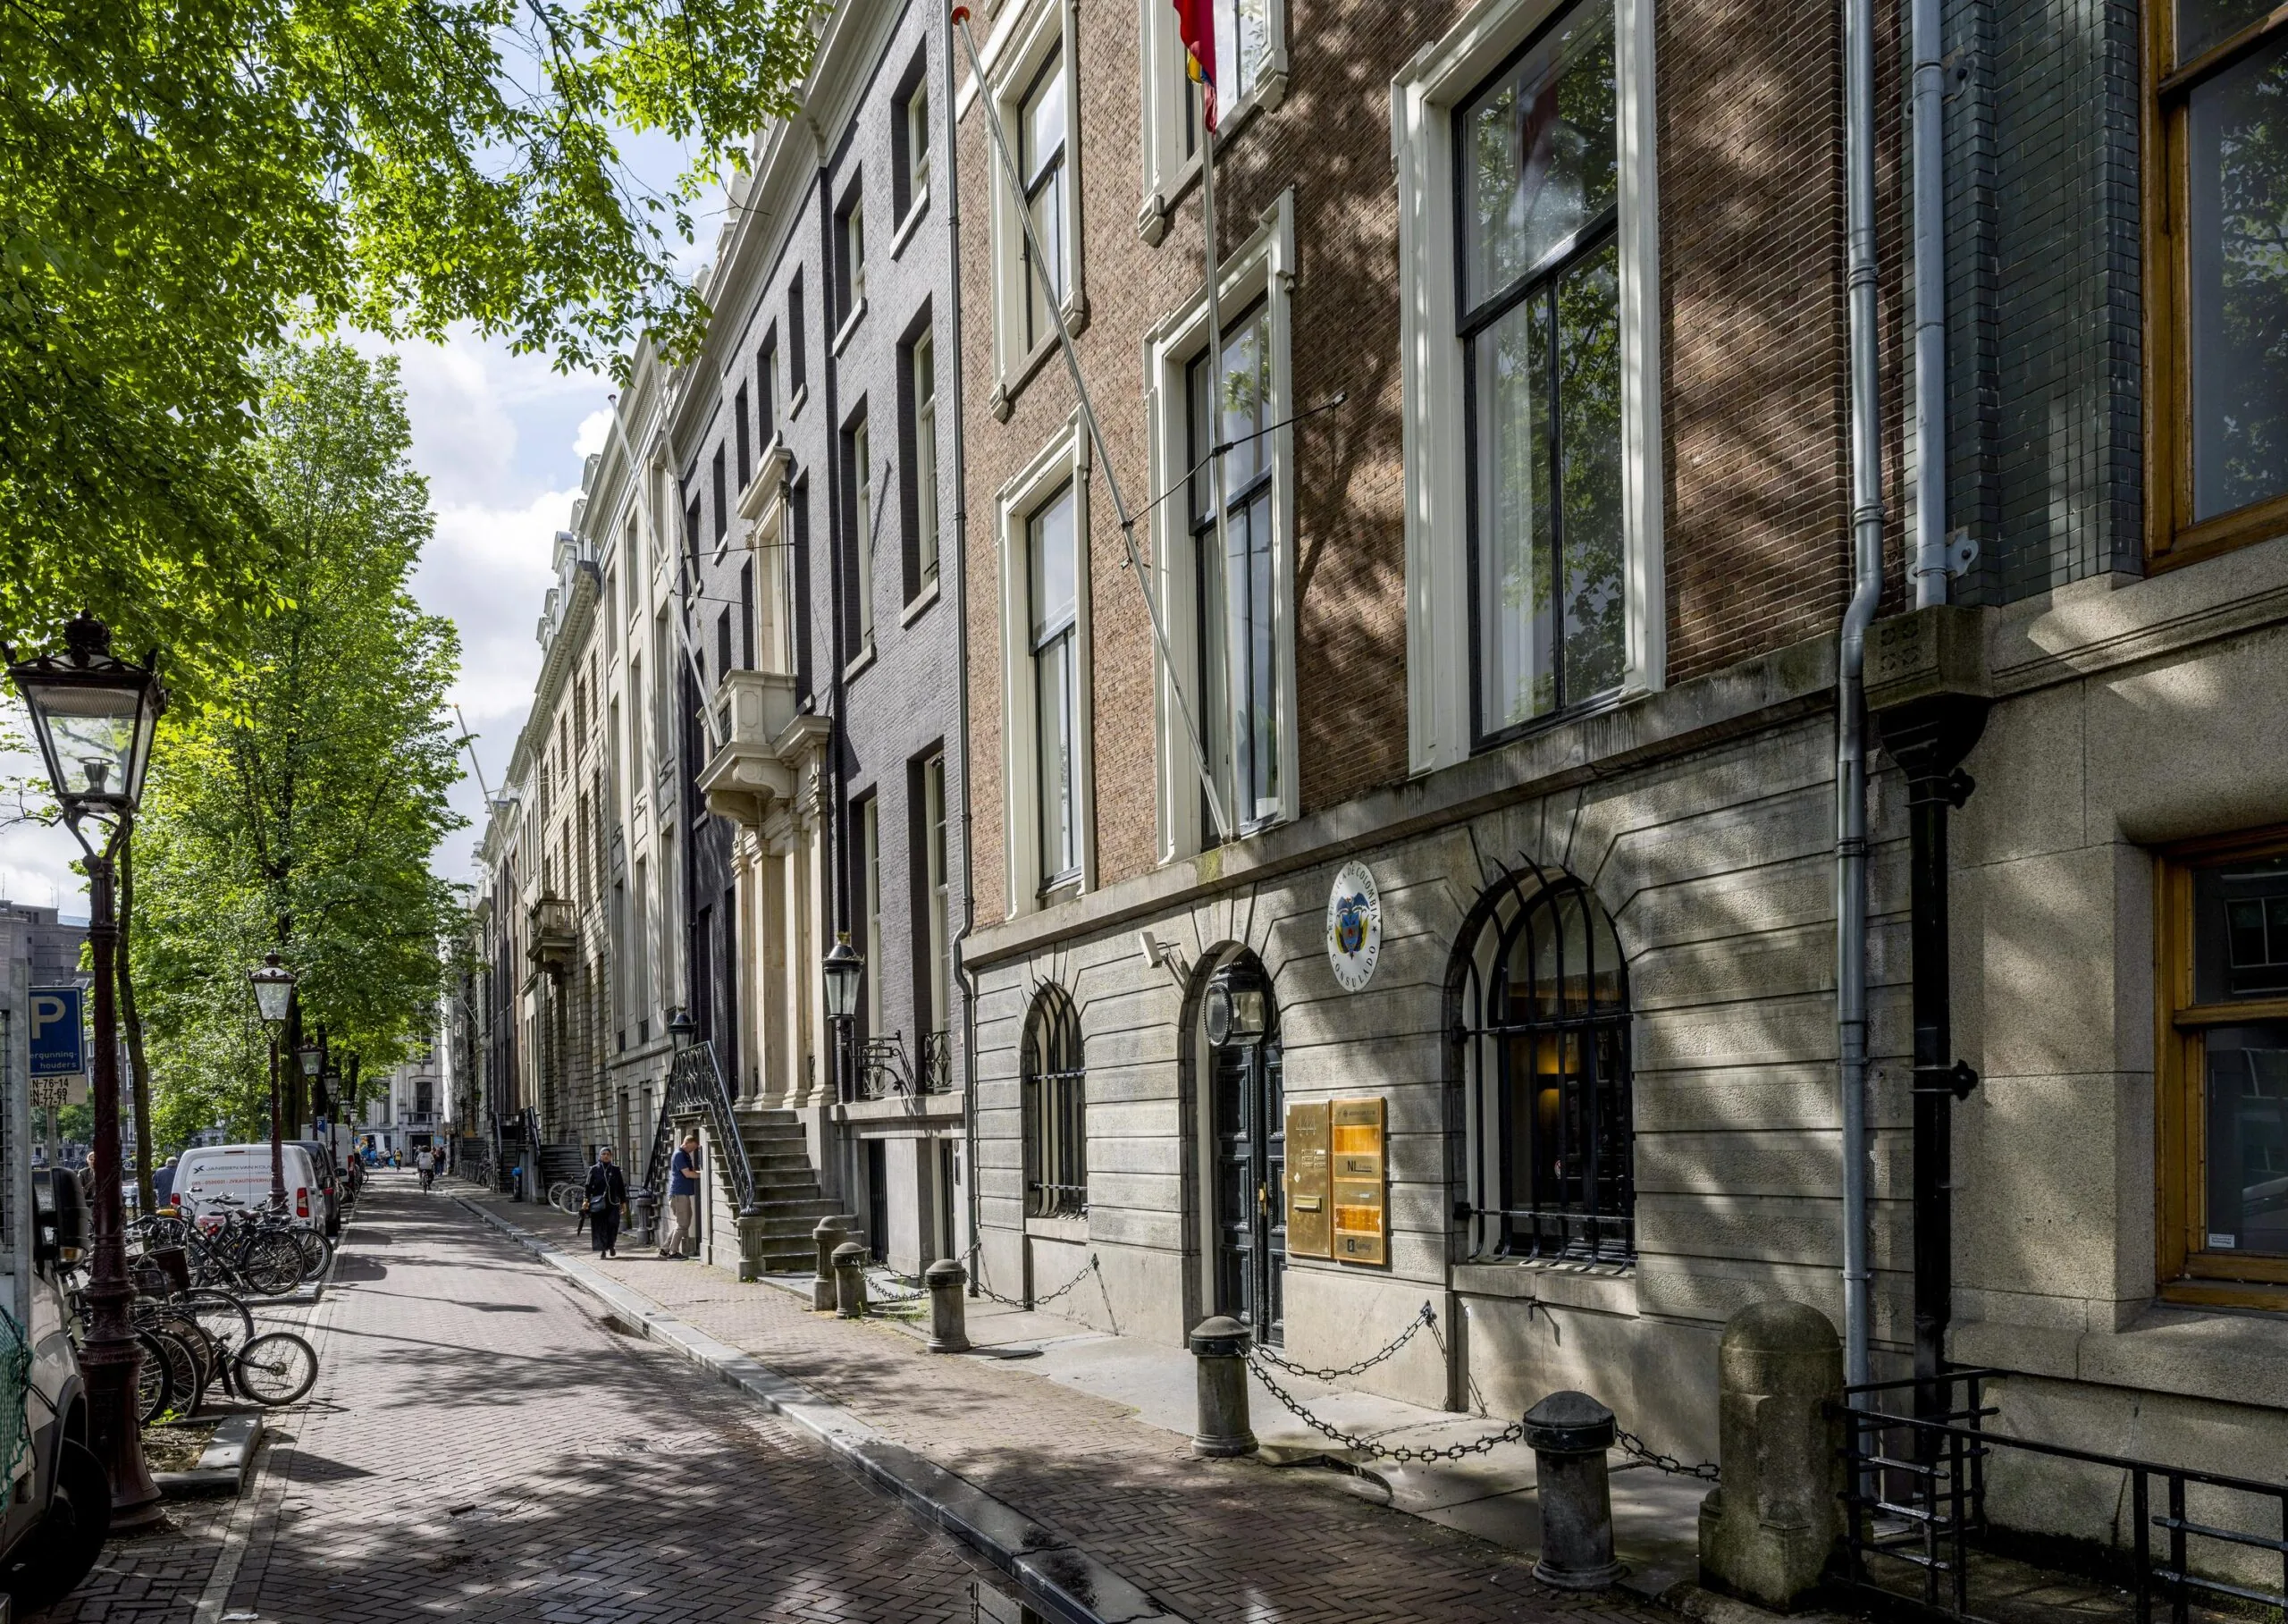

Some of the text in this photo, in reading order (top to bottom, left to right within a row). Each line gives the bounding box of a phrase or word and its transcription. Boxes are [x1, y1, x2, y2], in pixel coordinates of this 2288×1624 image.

[1347, 867, 1355, 877] DE
[1356, 866, 1377, 921] COLOMBIA
[1332, 946, 1376, 988] CONSULADO
[29, 996, 66, 1039] P
[29, 1050, 77, 1060] ergunning-
[40, 1061, 77, 1070] houders
[30, 1077, 69, 1089] N-76-14
